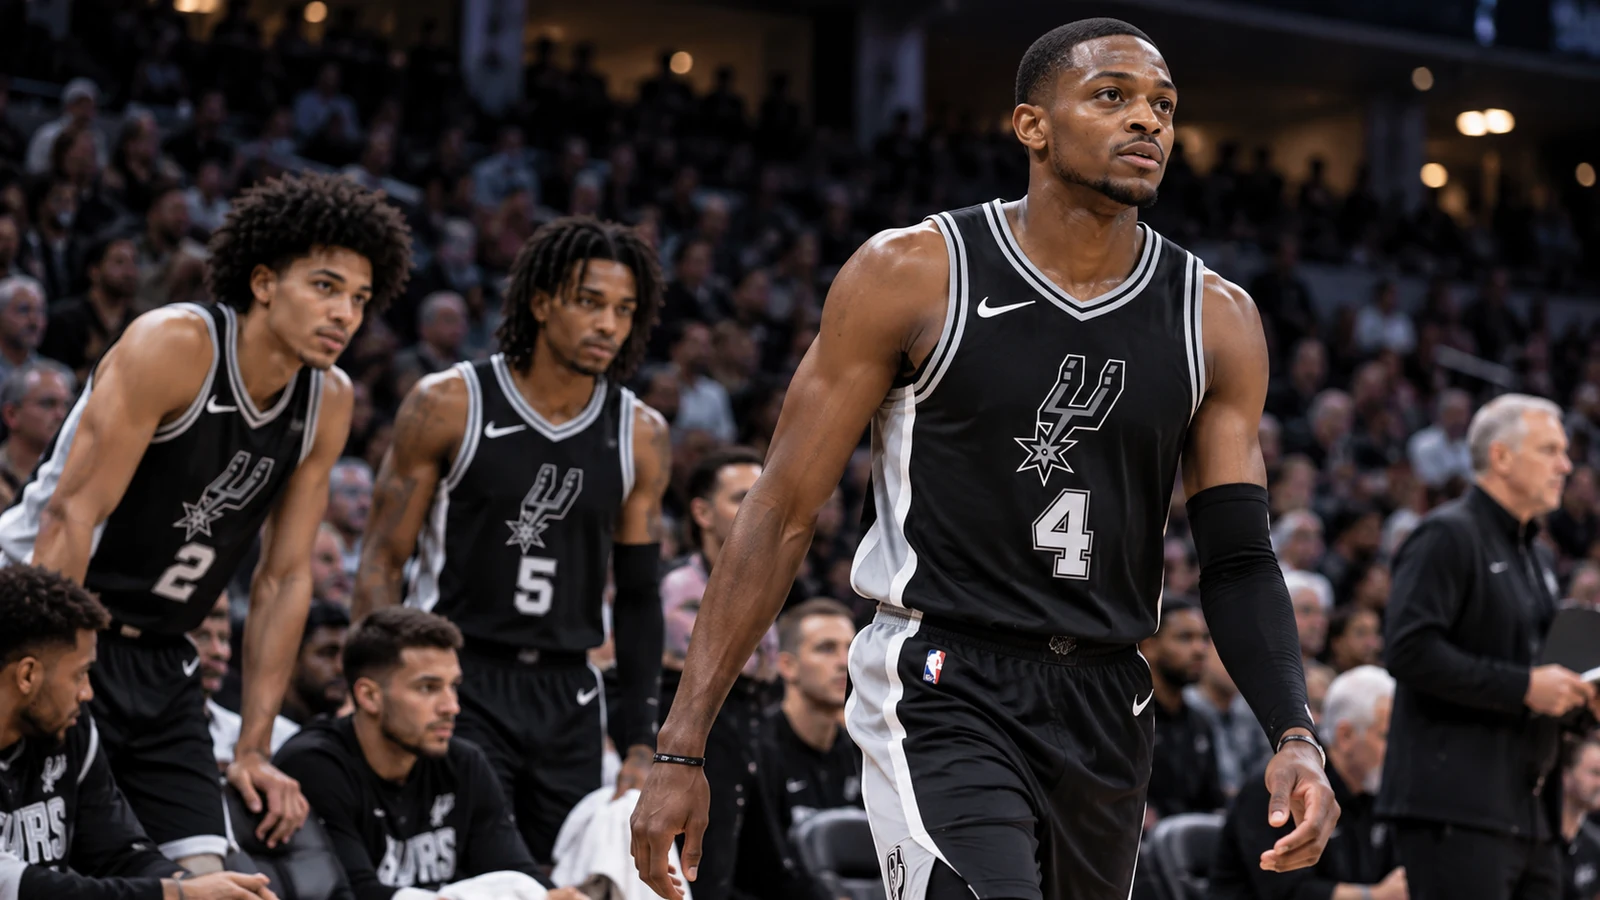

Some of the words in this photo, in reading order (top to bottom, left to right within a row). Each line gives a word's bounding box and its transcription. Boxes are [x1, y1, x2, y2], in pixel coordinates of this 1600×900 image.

[1032, 488, 1094, 580] 4
[151, 541, 216, 603] 2
[513, 555, 558, 617] 5
